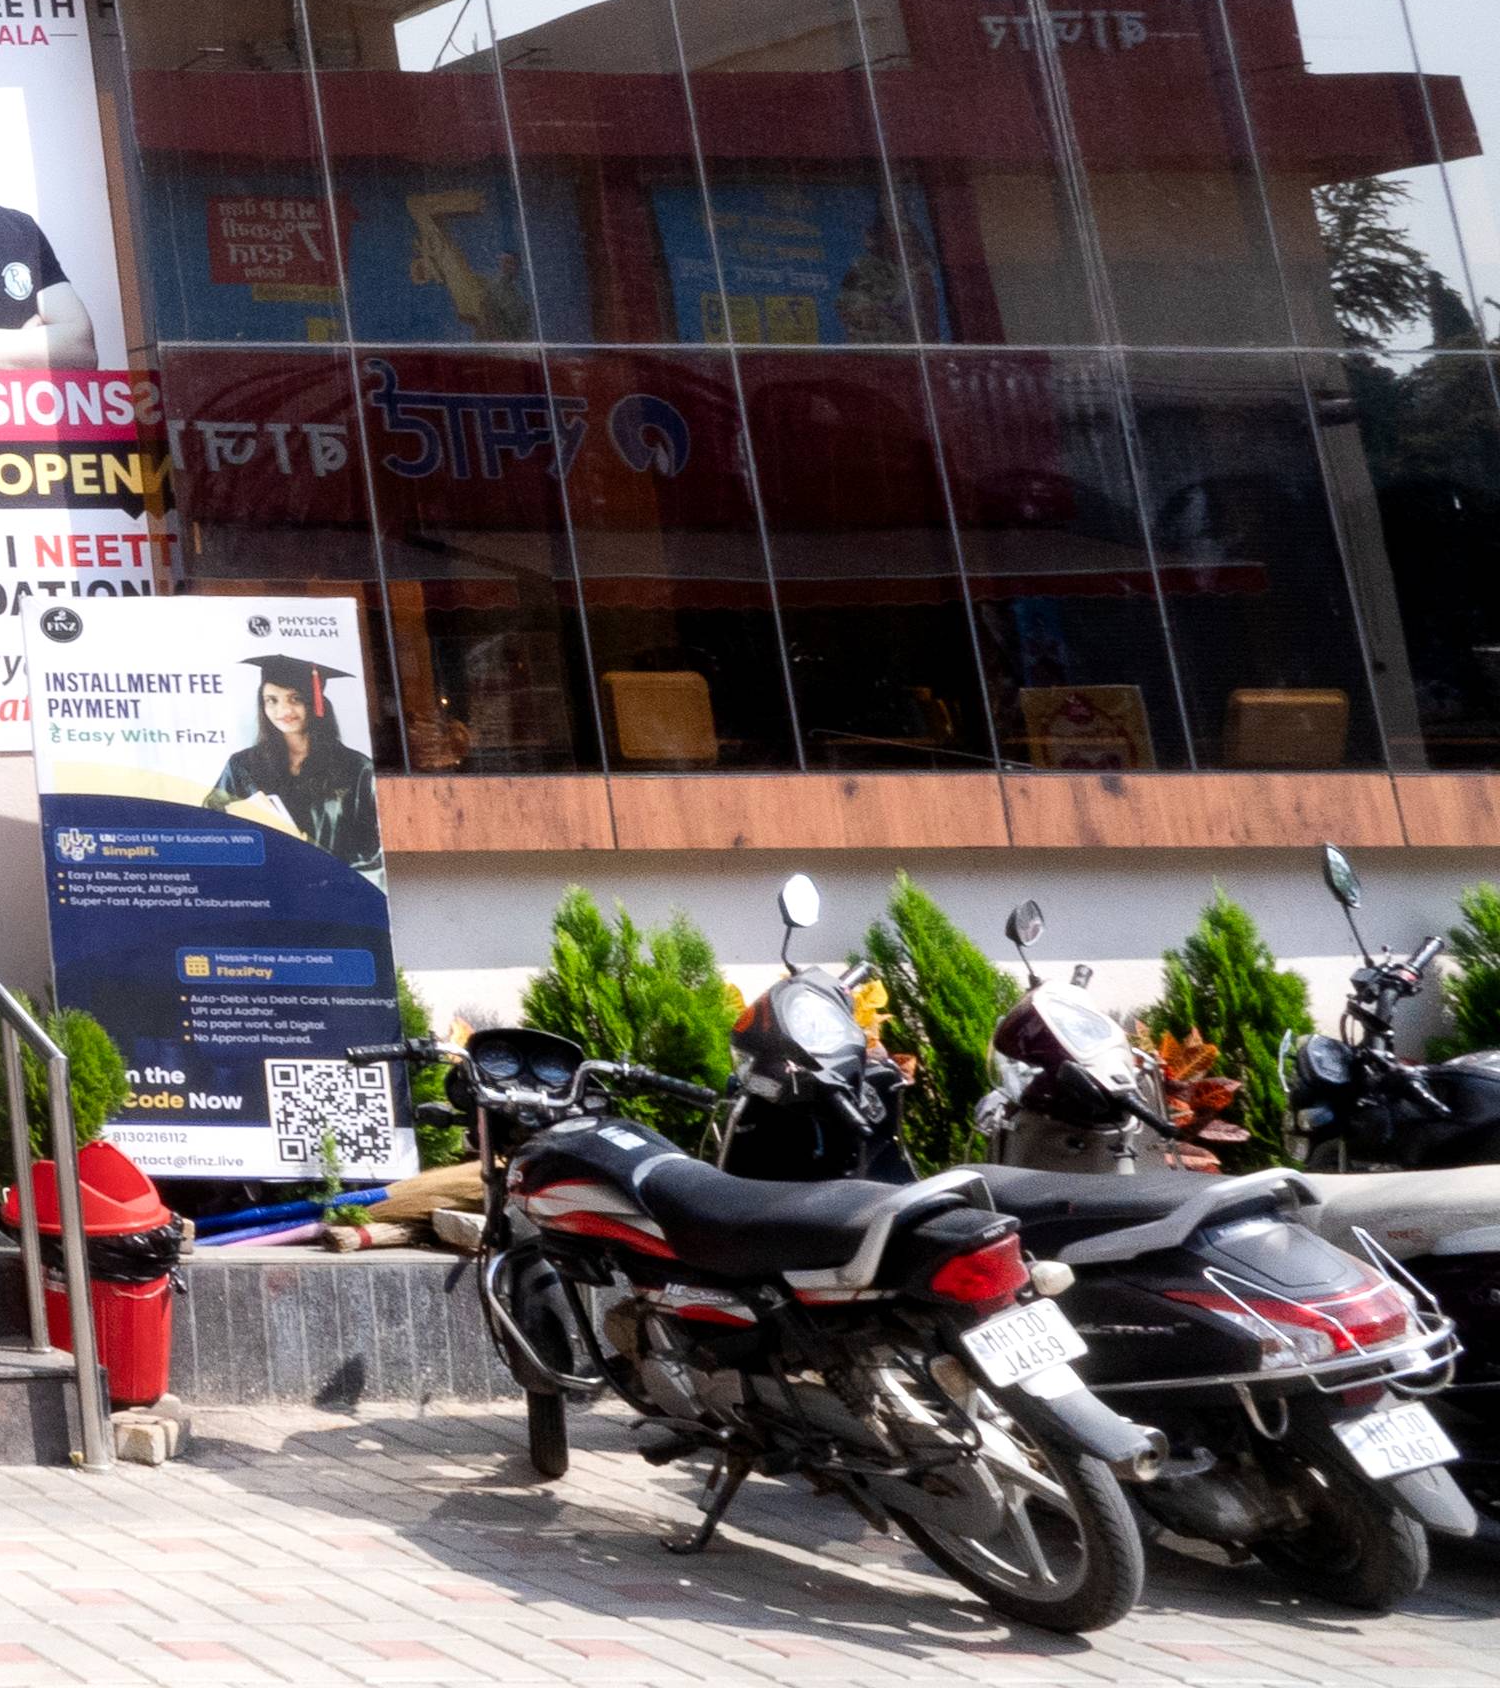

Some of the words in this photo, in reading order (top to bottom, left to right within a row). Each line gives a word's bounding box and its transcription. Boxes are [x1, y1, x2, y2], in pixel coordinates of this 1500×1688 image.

[33, 534, 152, 569] NEET
[46, 621, 77, 633] FINZ
[277, 615, 338, 628] PHYSICS
[278, 627, 340, 639] WALLAH
[44, 670, 183, 696] INSTALLMENT
[188, 672, 225, 695] FEE
[47, 697, 142, 721] PAYMENT
[66, 728, 116, 747] Easy
[121, 728, 172, 745] With
[175, 729, 227, 745] FinZ!
[176, 834, 230, 845] Education,
[231, 835, 254, 844] With
[67, 871, 93, 882] Easy
[123, 871, 148, 881] Zero
[149, 872, 191, 882] Interest
[86, 885, 147, 896] Paperwork,
[163, 885, 199, 896] Digital
[69, 896, 131, 908] Super-Fast
[132, 897, 182, 909] Approval
[194, 898, 271, 909] Disbursement
[214, 953, 276, 964] Hassle-Free
[277, 954, 334, 964] Auto-Debit
[216, 966, 273, 980] FlexiPay
[190, 994, 250, 1005] Auto-Debit
[251, 995, 268, 1005] via
[269, 995, 299, 1005] Debit
[300, 996, 331, 1006] Card,
[210, 1006, 233, 1016] and
[210, 1020, 243, 1031] paper
[244, 1019, 273, 1030] work,
[211, 1033, 261, 1045] Approval
[261, 1034, 313, 1045] Required.
[144, 1066, 187, 1085] the
[188, 1092, 244, 1111] Now
[1004, 1335, 1067, 1377] J4459
